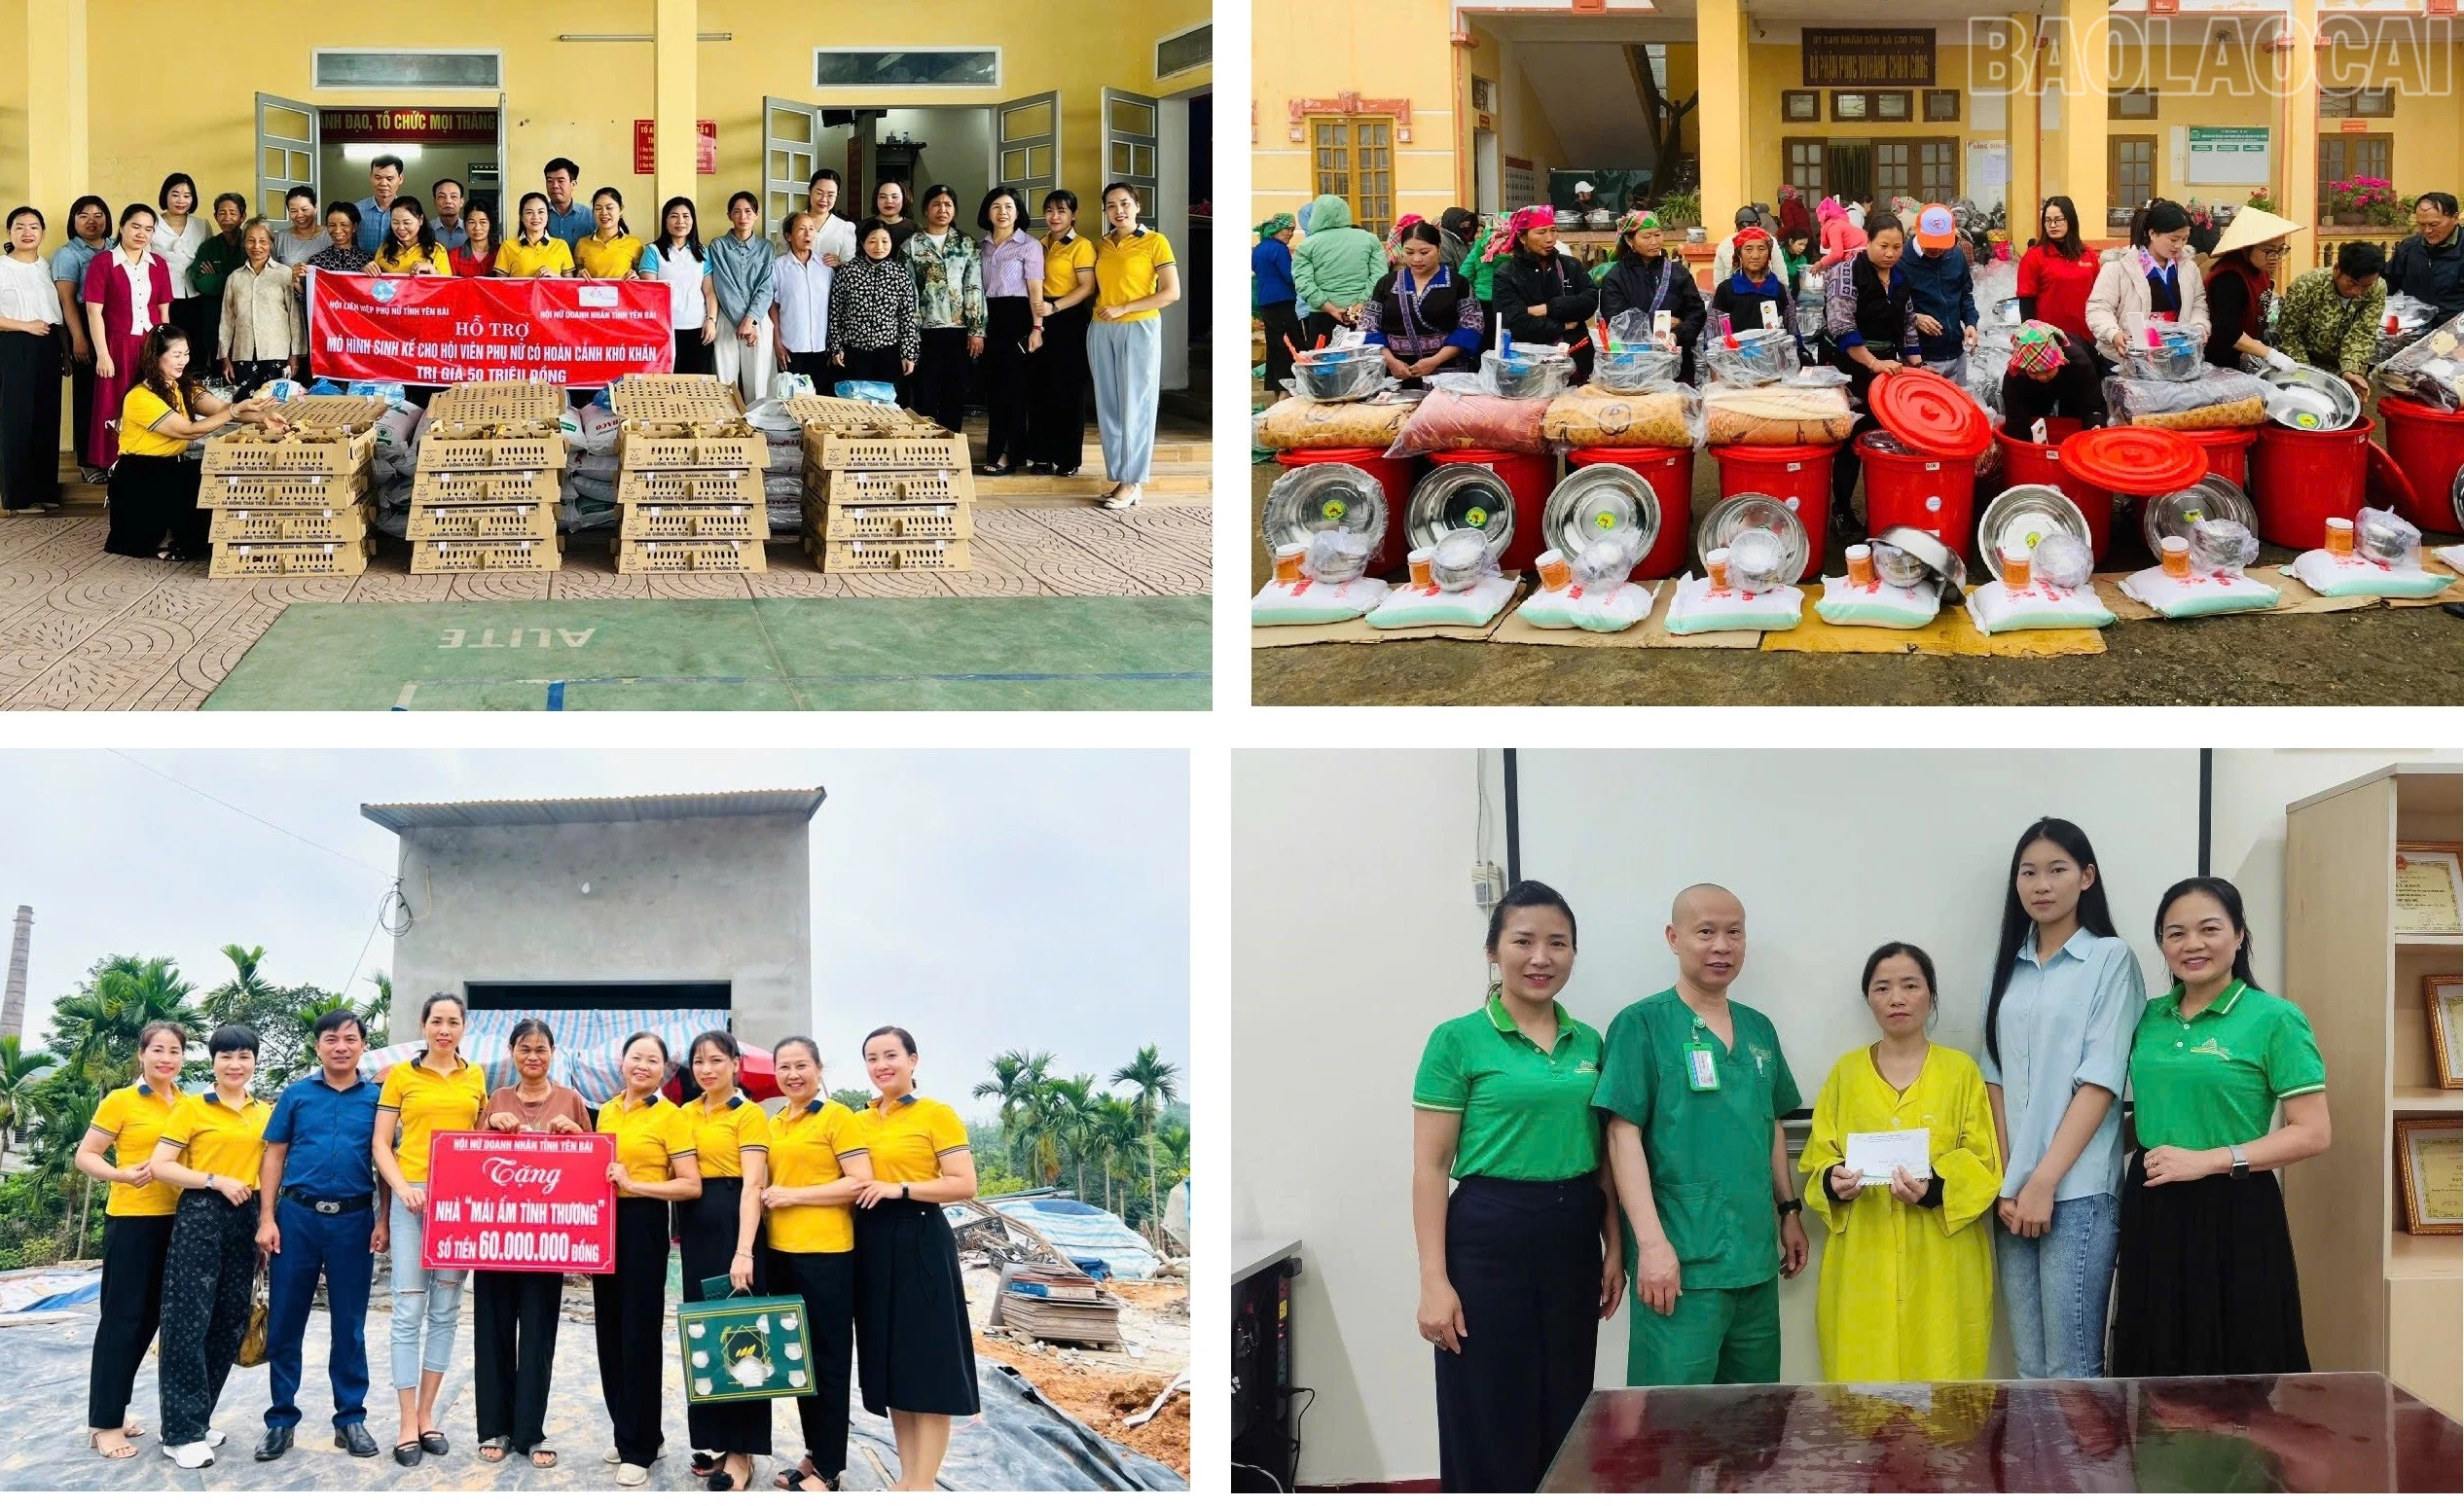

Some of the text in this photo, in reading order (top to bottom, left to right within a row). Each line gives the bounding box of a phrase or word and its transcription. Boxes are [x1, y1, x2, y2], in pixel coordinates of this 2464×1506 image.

[394, 110, 426, 129] CHỨC
[430, 114, 453, 133] MỌI
[329, 300, 342, 310] HỘI
[344, 302, 359, 310] LIÊN
[376, 307, 390, 316] PHỤ
[421, 306, 435, 315] YÊN
[437, 306, 449, 316] BÁI
[540, 311, 552, 319] HỘI
[591, 310, 609, 319] NHÂN
[629, 310, 642, 319] YÊN
[645, 310, 656, 319] BÁI
[455, 315, 529, 341] HỖ TRỢ
[327, 335, 344, 352] MÔ
[373, 340, 399, 356] SINH
[401, 337, 416, 357] KẾ
[418, 343, 438, 358] CHO
[441, 341, 457, 362] HỘI
[460, 341, 483, 360] VIÊN
[486, 345, 507, 364] PHỤ
[510, 343, 526, 360] NỮ
[527, 343, 540, 360] CÓ
[544, 343, 571, 361] HOÀN
[575, 341, 603, 361] CẢNH
[605, 343, 625, 361] KHÓ
[629, 343, 656, 361] KHĂN
[416, 366, 437, 383] TRỊ
[441, 365, 464, 381] GIÁ
[467, 368, 484, 381] 50
[530, 365, 566, 383] ĐỒNG
[438, 628, 596, 648] ALITE
[454, 1138, 593, 1152] HỘI NỮ DOANH NHÂN TỈNH YÊN BÁI
[482, 1157, 562, 1194] Tặng
[435, 1197, 460, 1222] NHÀ
[497, 1195, 516, 1223] ẤM
[520, 1201, 547, 1224] TÌNH
[437, 1230, 599, 1262] SỐ TIỀN 60.000.000 ĐỒNG
